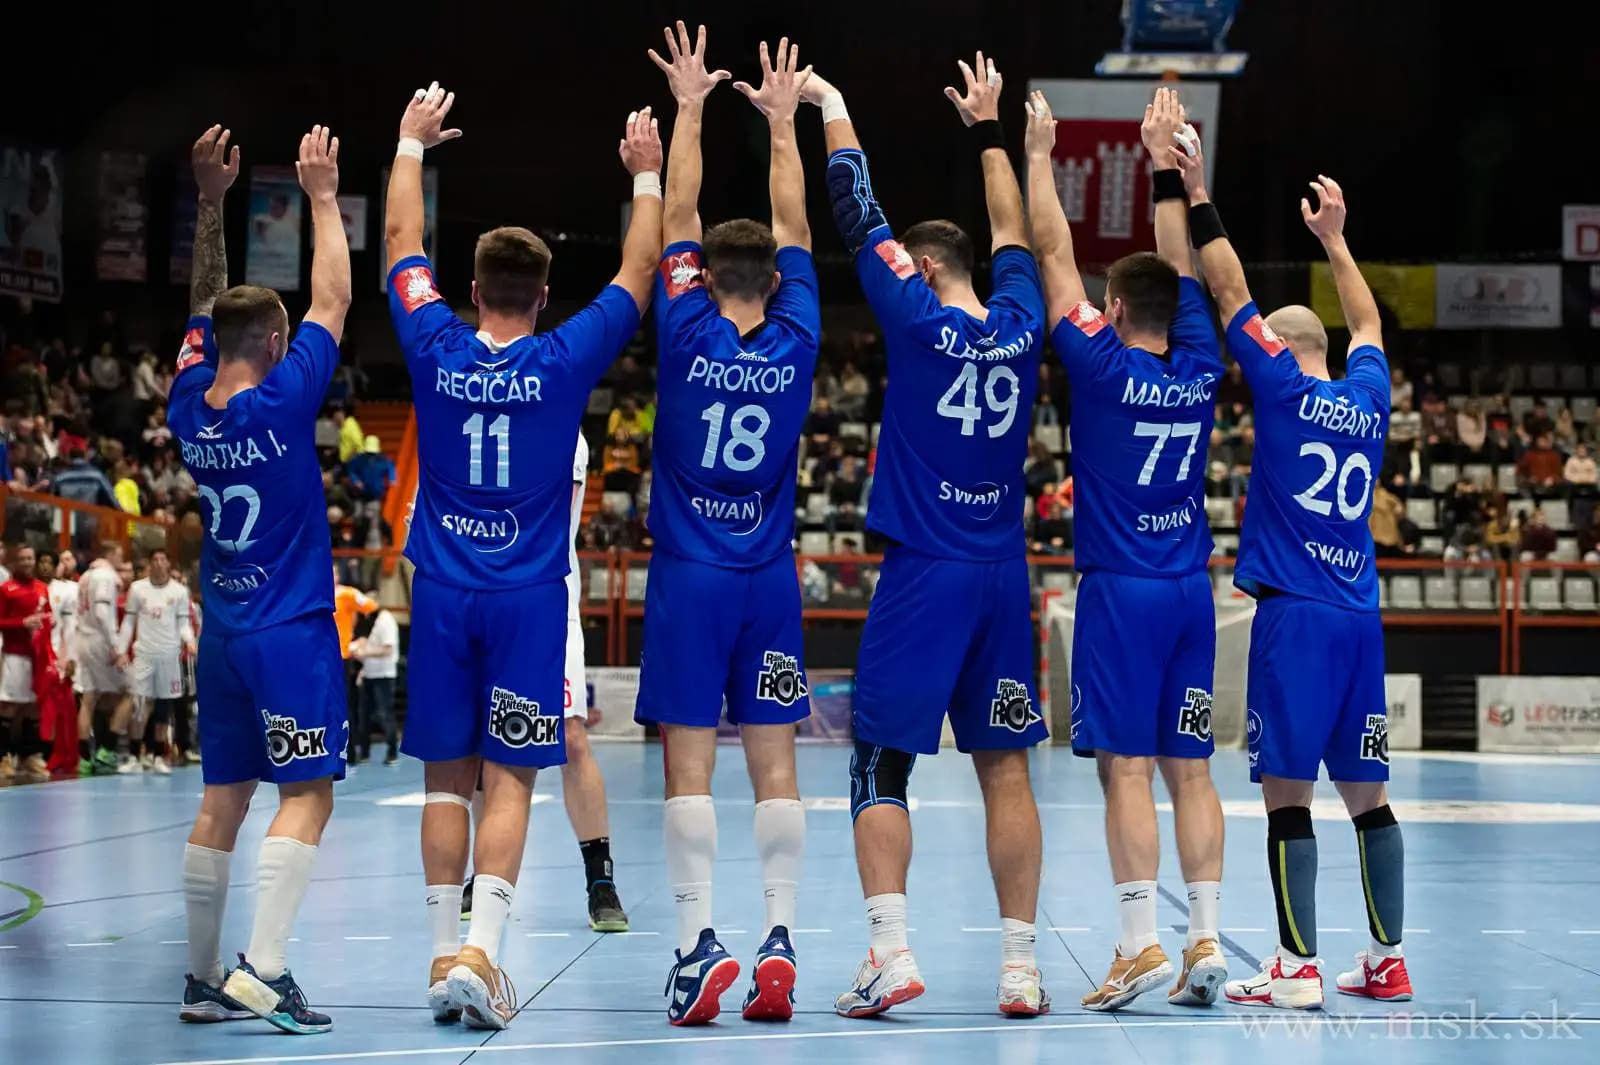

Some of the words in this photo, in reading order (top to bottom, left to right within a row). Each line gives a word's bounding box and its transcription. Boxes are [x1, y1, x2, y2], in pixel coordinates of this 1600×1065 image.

[686, 355, 795, 394] PROKOP
[937, 362, 1020, 438] 49
[462, 412, 510, 487] 11
[701, 401, 771, 471] 18
[1133, 421, 1202, 486] 77
[938, 481, 1000, 504] SWAN
[1293, 442, 1372, 520] 20
[442, 513, 506, 537] SWAN
[691, 497, 756, 520] SWAN
[1137, 507, 1192, 532] SWAN
[1304, 541, 1359, 569] SWAN
[267, 729, 325, 765] OCK
[489, 711, 559, 747] ROCK
